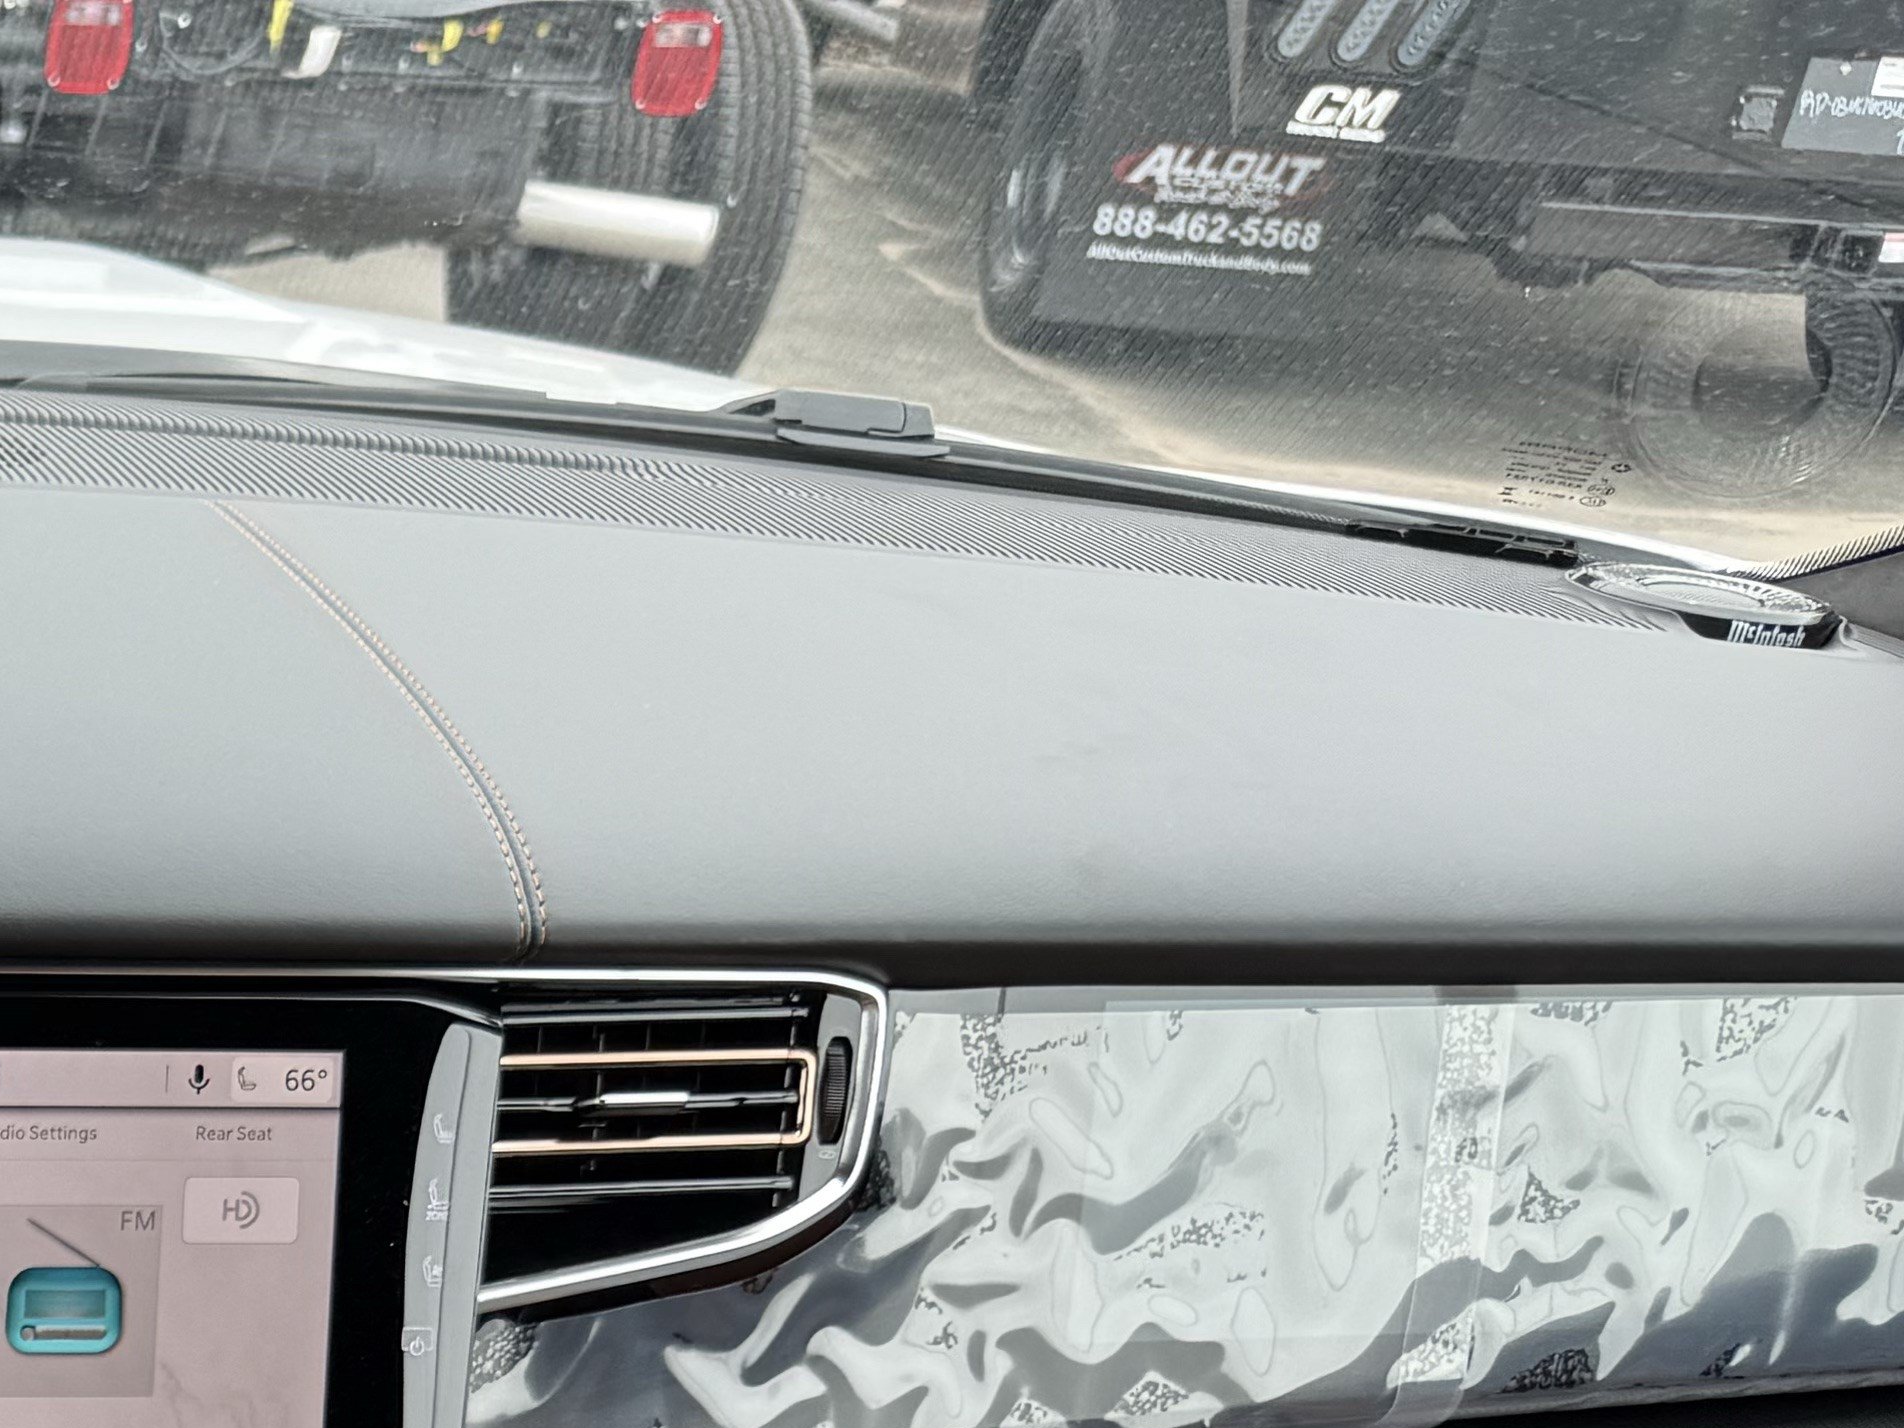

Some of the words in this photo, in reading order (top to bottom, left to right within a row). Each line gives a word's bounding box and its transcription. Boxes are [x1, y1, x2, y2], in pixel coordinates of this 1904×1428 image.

[1295, 85, 1401, 128] CM
[1093, 203, 1323, 252] 888-462-5568
[1726, 619, 1807, 647] McIntosh
[284, 1068, 329, 1092] 66°
[28, 1125, 99, 1145] Settings
[195, 1126, 233, 1142] Rear
[235, 1126, 274, 1142] Seat
[119, 1211, 157, 1231] FM
